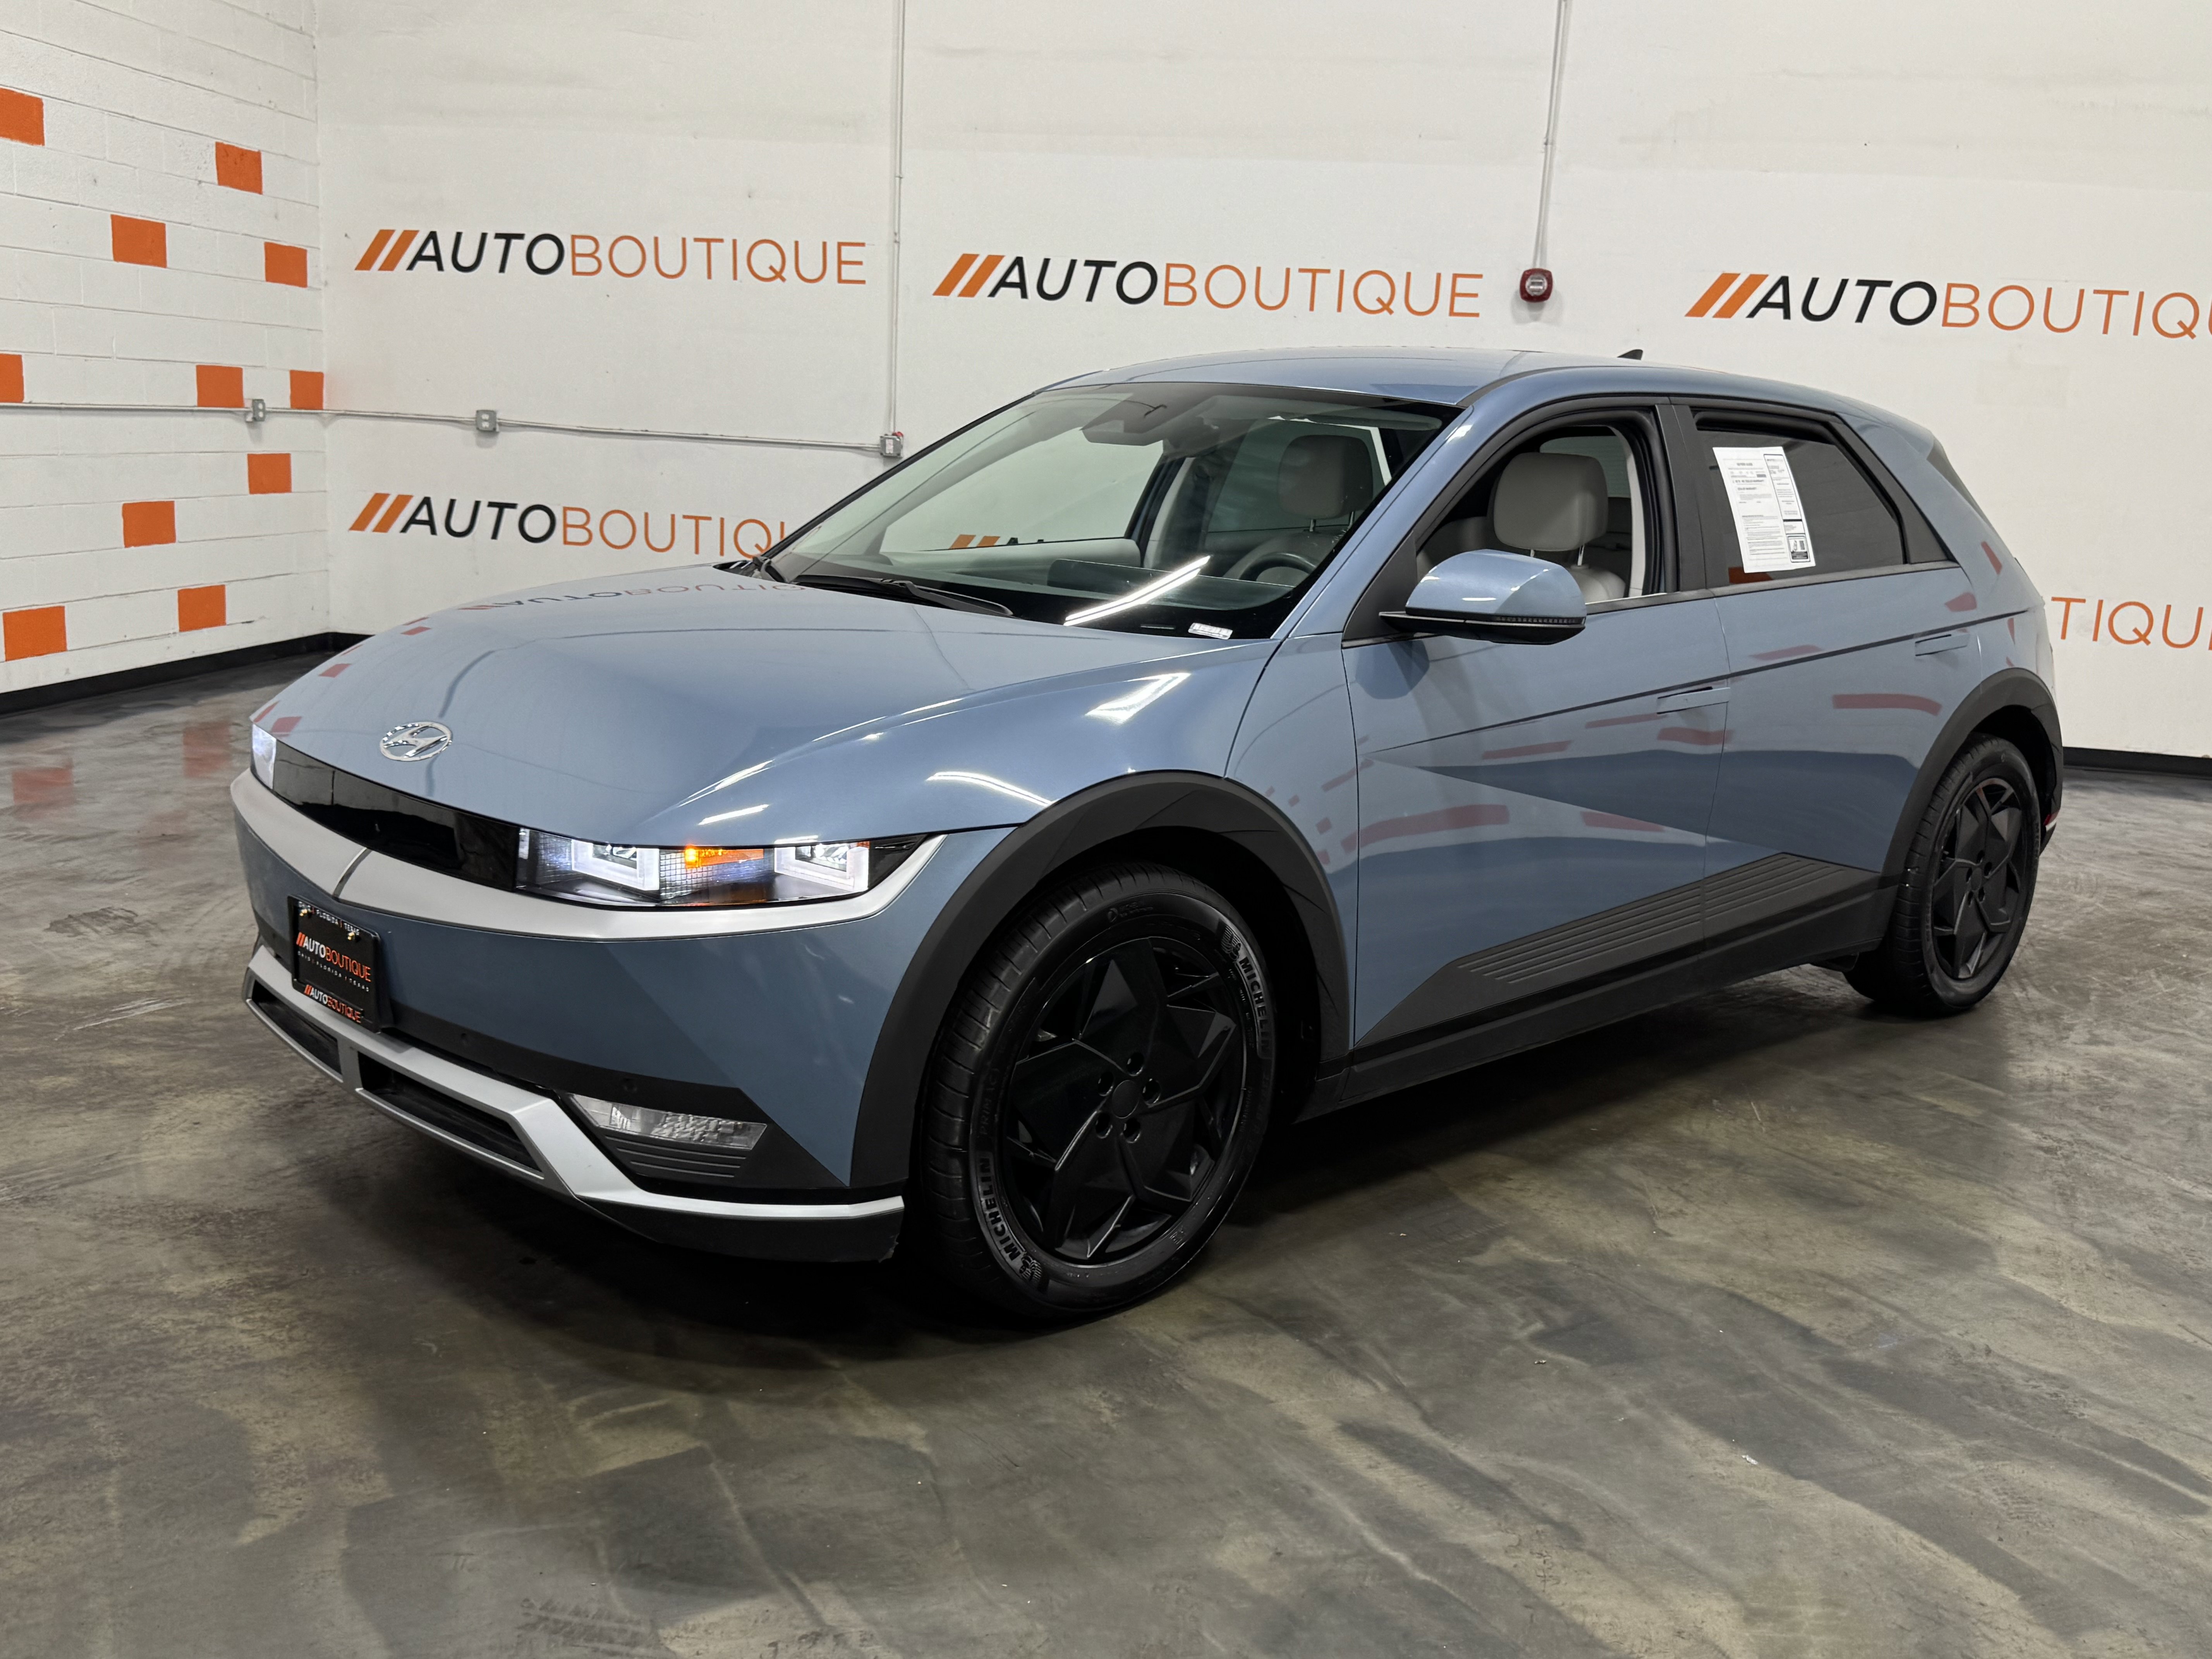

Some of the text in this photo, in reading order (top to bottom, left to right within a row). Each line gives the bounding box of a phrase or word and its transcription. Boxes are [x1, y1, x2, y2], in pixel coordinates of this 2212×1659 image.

[1747, 275, 2212, 340] AUTOBOUTIQ
[302, 936, 372, 982] AUTOBOUTIQUE
[1239, 957, 1271, 1053] MICHELIN
[979, 1158, 1022, 1261] MICHELIN
